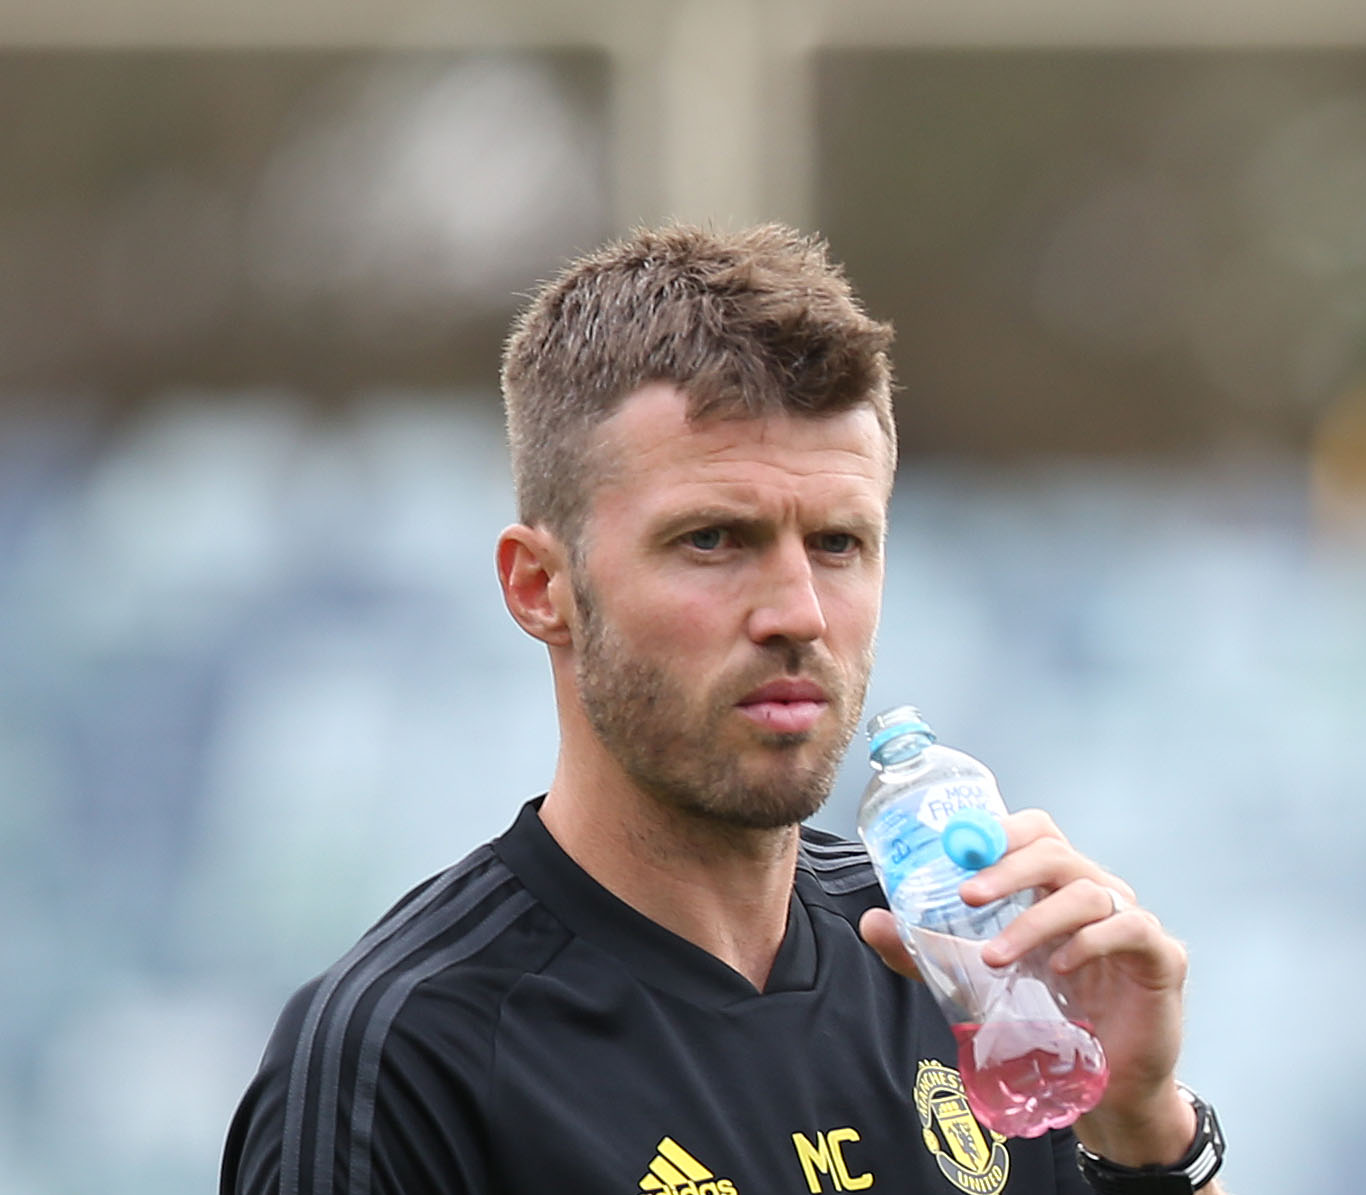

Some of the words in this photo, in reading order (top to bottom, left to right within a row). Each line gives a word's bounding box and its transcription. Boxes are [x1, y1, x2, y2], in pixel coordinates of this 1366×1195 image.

[944, 785, 984, 800] MOU
[918, 1070, 966, 1119] MANCHES
[792, 1128, 874, 1194] MC
[957, 1164, 1003, 1193] UNITED
